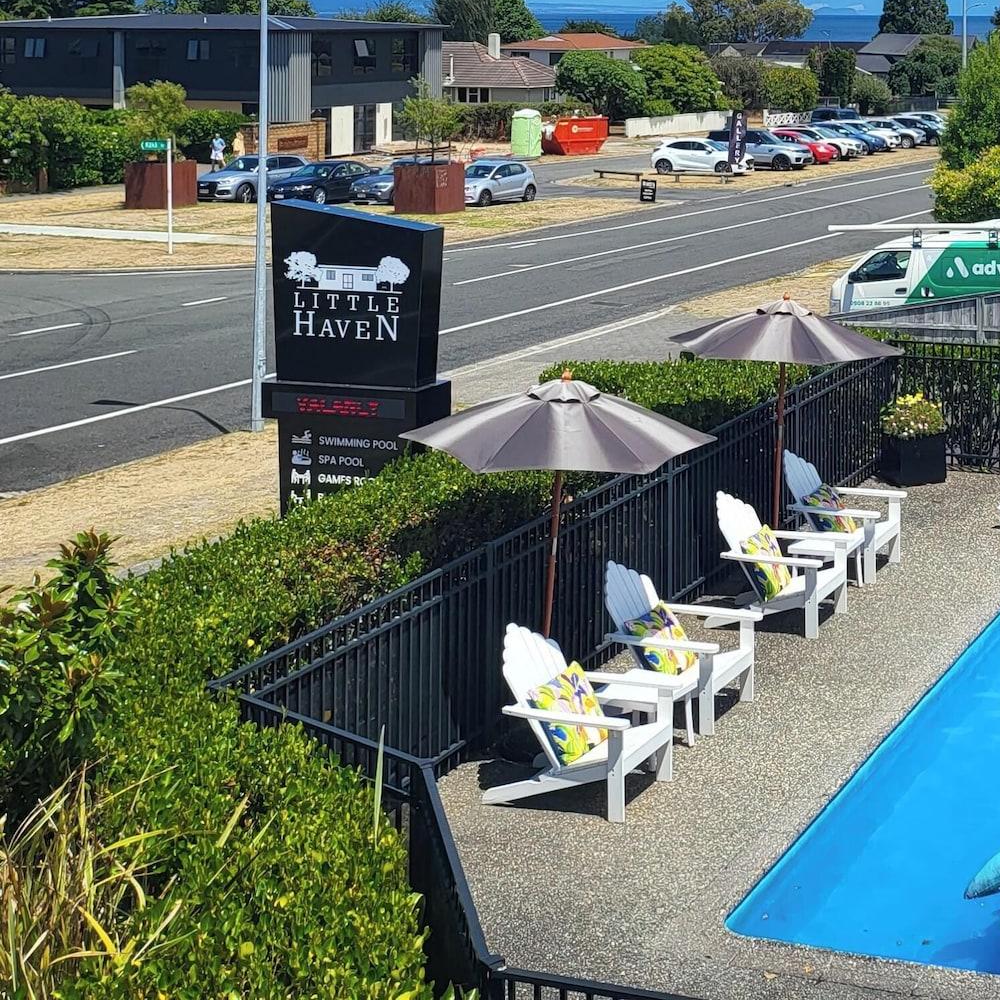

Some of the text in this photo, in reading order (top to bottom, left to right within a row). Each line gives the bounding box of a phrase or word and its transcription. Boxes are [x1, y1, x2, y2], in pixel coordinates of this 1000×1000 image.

[735, 112, 743, 164] GALLERY
[293, 291, 400, 314] LITTLE
[292, 310, 400, 341] HAVEN
[318, 435, 399, 451] SWIMMING POOL
[318, 454, 365, 468] SPA POOL
[317, 473, 352, 486] GAMES
